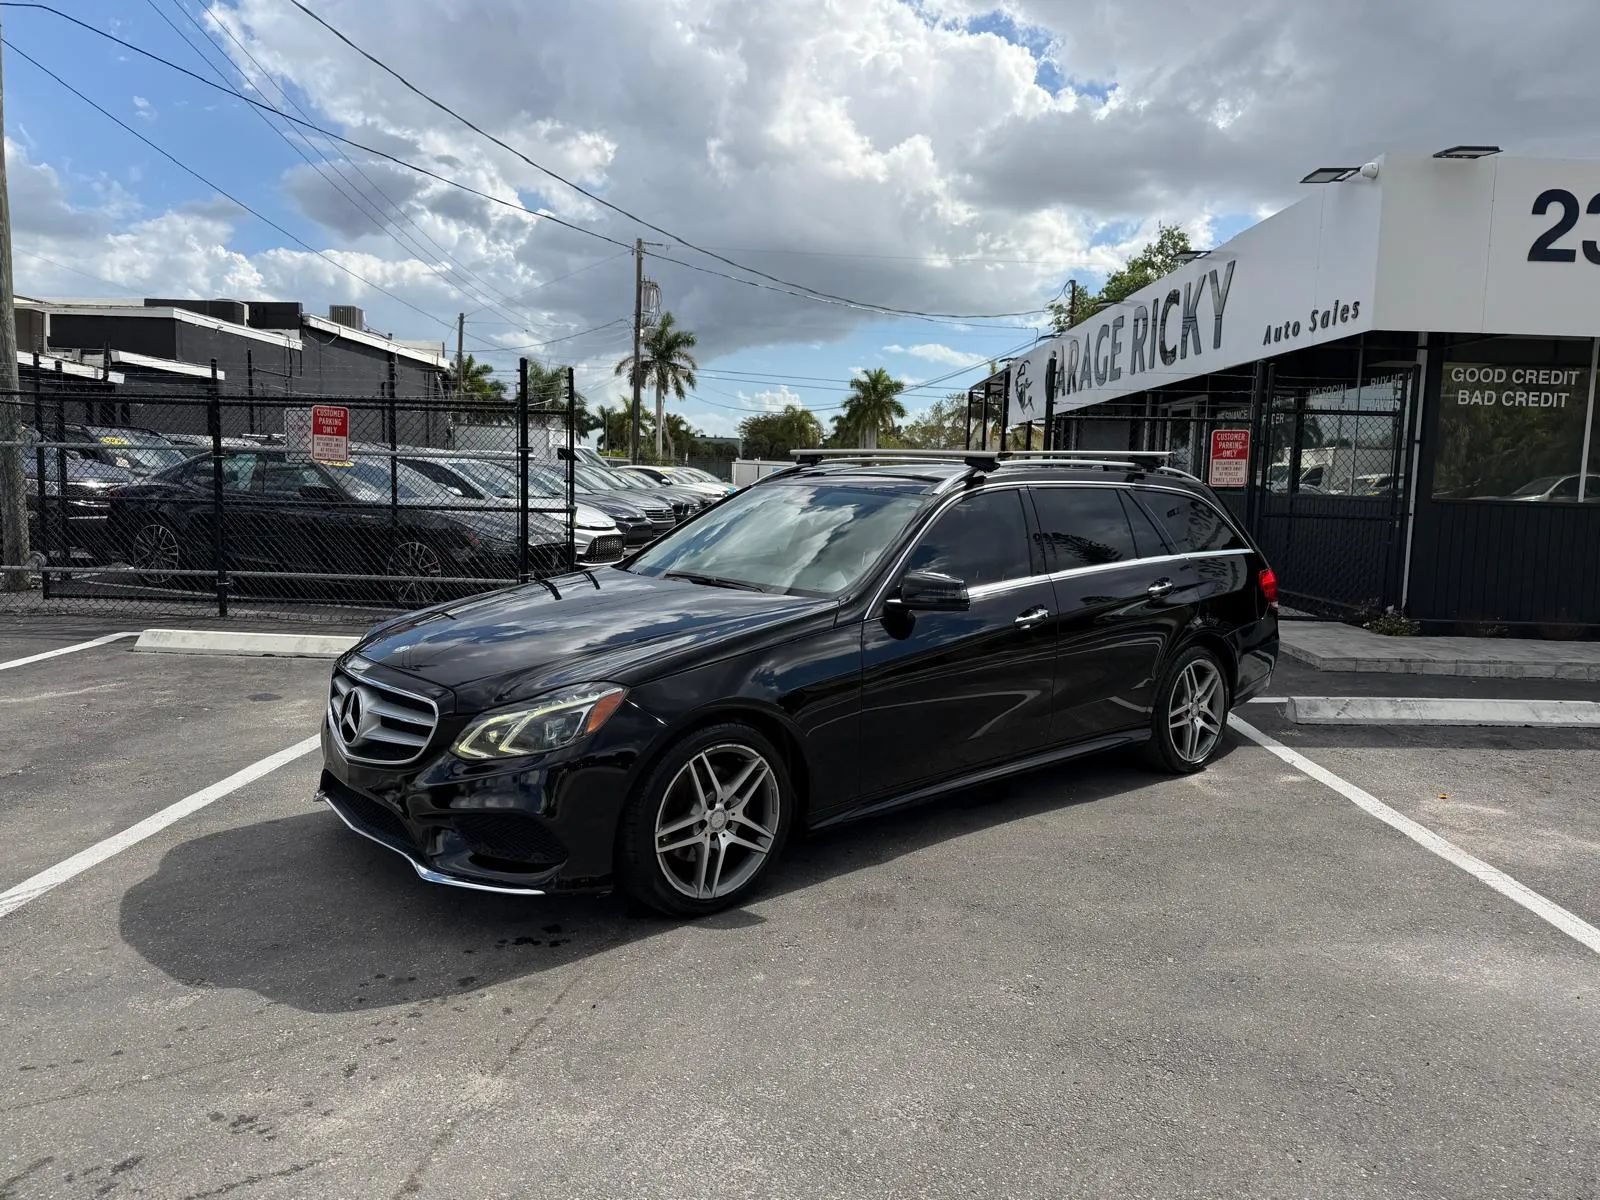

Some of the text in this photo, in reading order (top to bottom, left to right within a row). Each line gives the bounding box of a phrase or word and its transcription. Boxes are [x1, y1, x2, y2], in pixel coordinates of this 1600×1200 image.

[1262, 299, 1360, 346] Auto Sales
[1045, 260, 1236, 402] ARAGE RICKY
[1451, 367, 1580, 385] GOOD CREDIT
[1457, 390, 1570, 408] BAD CREDIT
[316, 408, 345, 418] CUSTOMER
[318, 417, 342, 426] PARKING
[322, 426, 338, 434] ONLY
[1216, 433, 1246, 441] CUSTOMER
[1218, 441, 1243, 449] PARKING
[1222, 449, 1238, 458] ONLY
